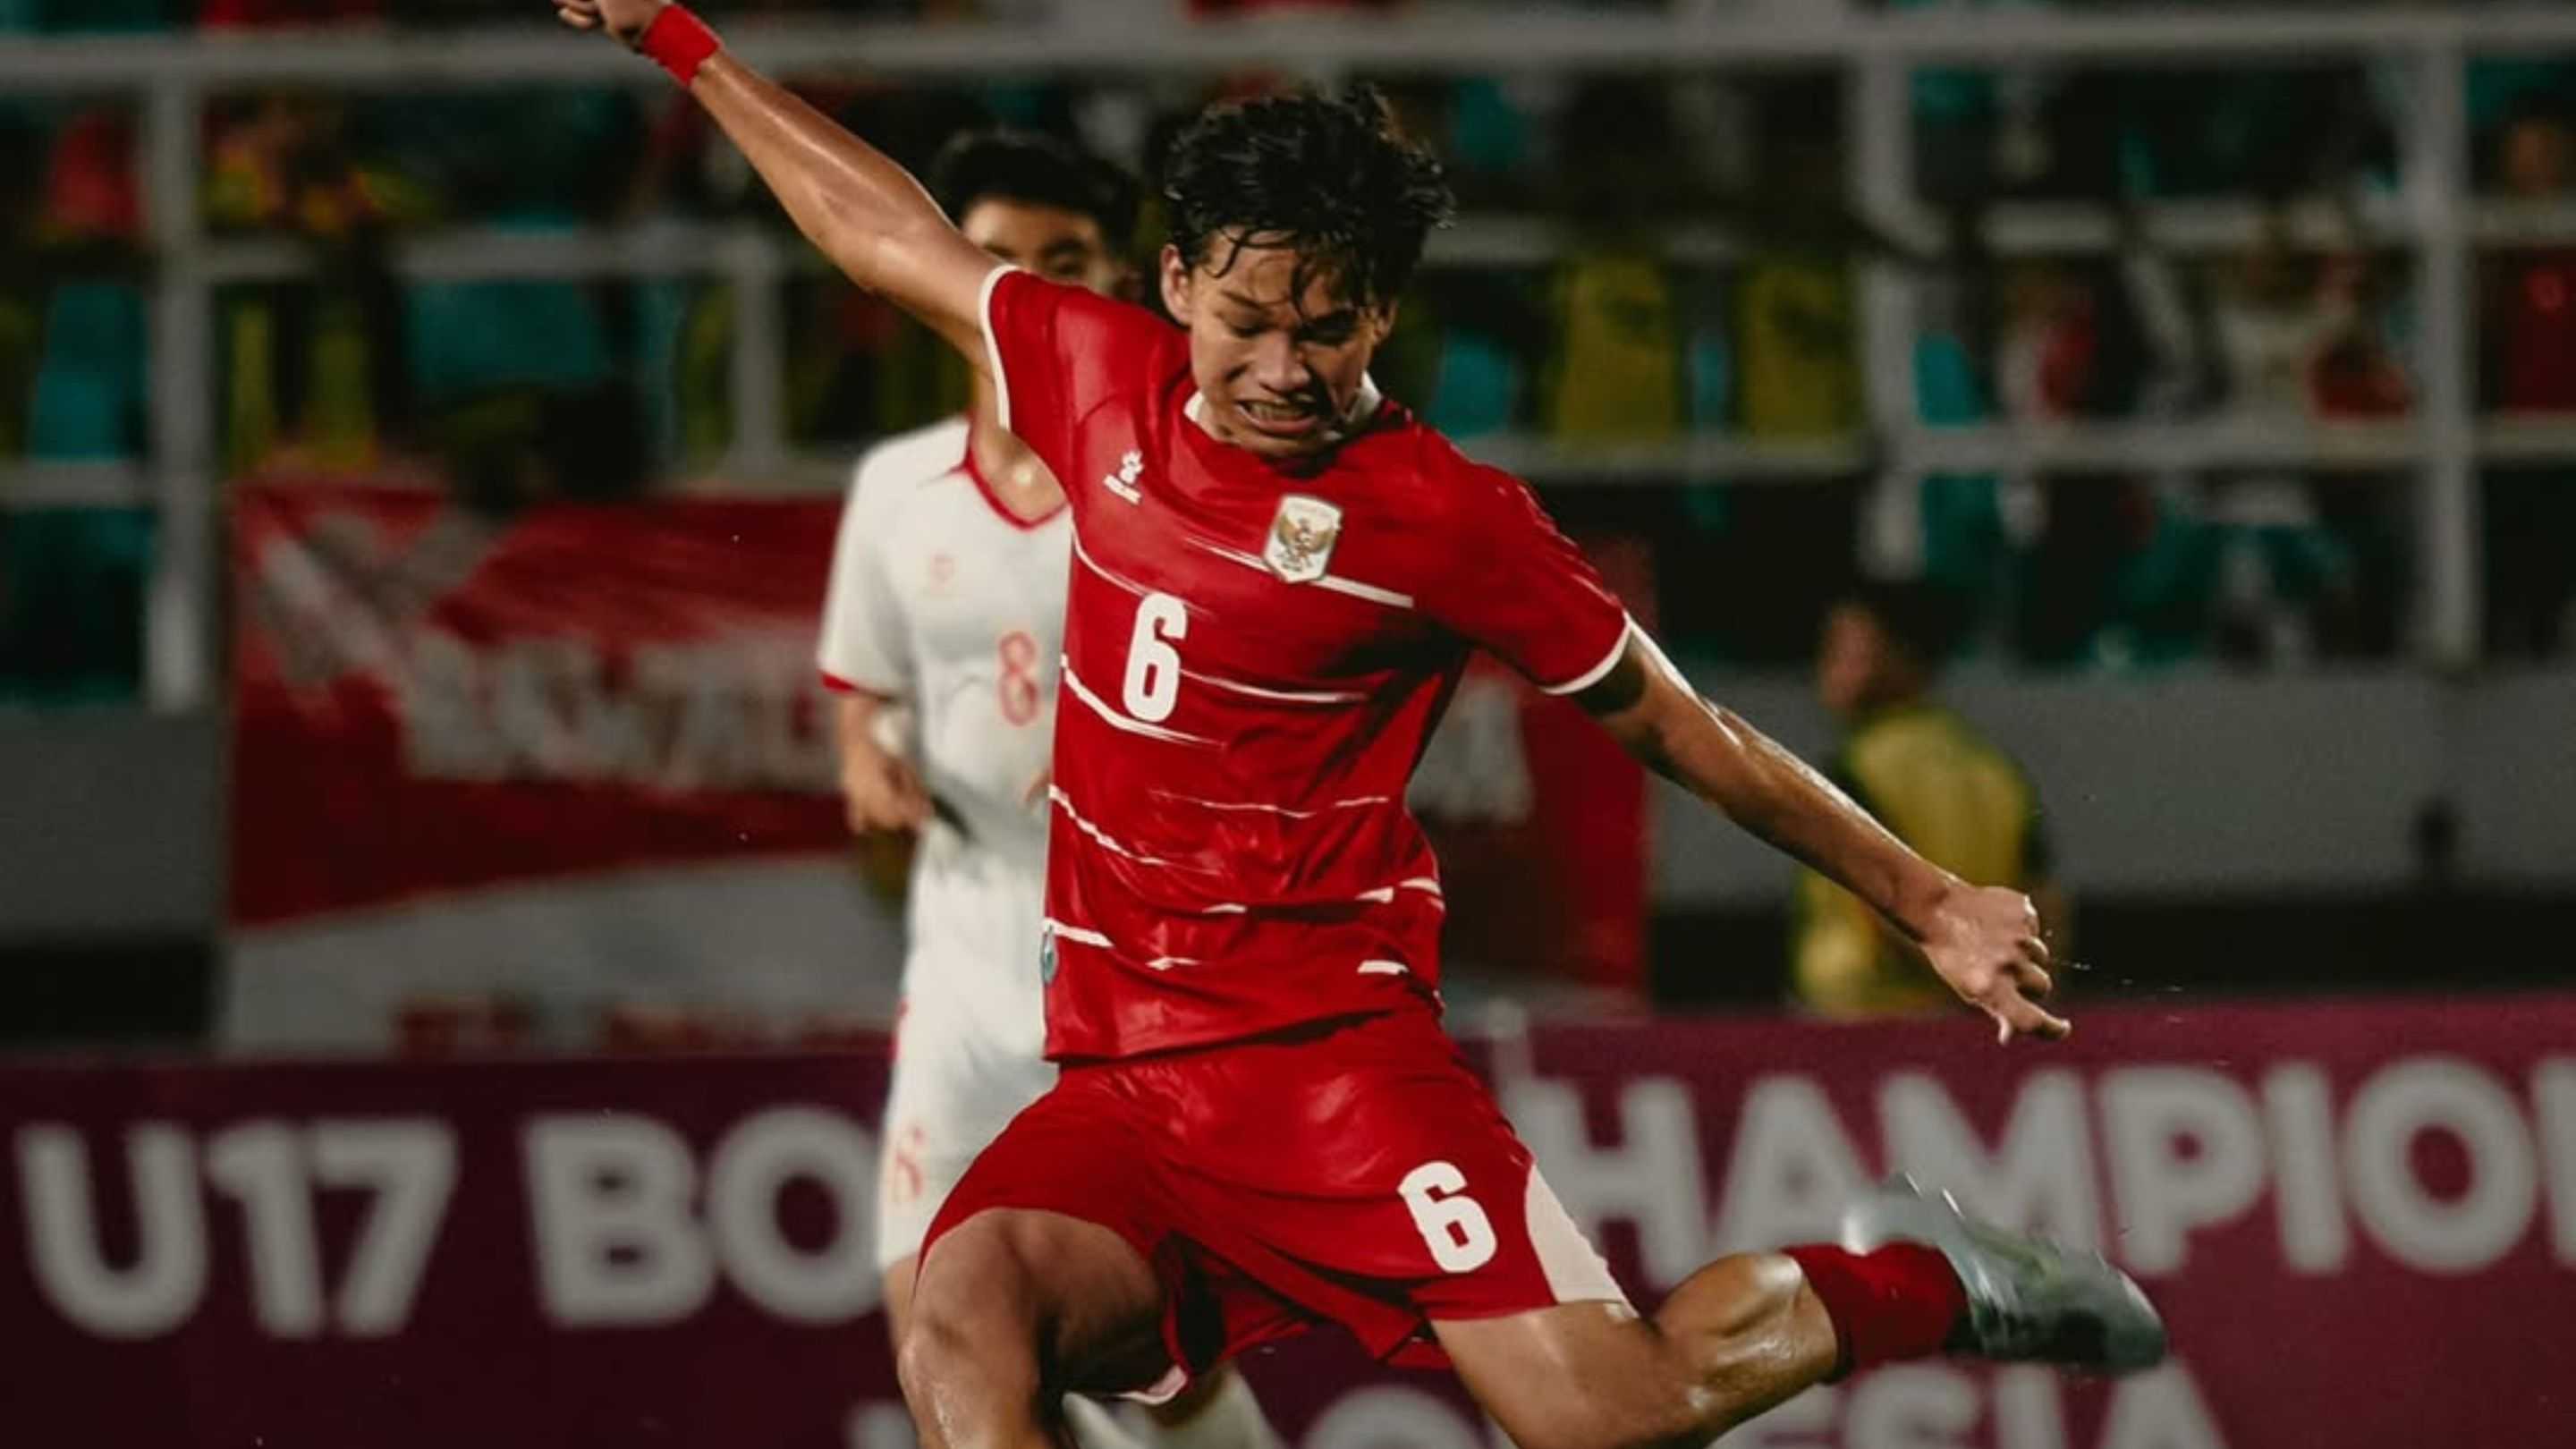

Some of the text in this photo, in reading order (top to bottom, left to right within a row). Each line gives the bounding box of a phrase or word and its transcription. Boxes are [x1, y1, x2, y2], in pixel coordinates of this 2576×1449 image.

[997, 630, 1039, 728] 8
[1123, 592, 1188, 723] 6
[15, 1054, 2576, 1341] U17 BO HAMPIO
[1397, 1160, 1498, 1274] 6
